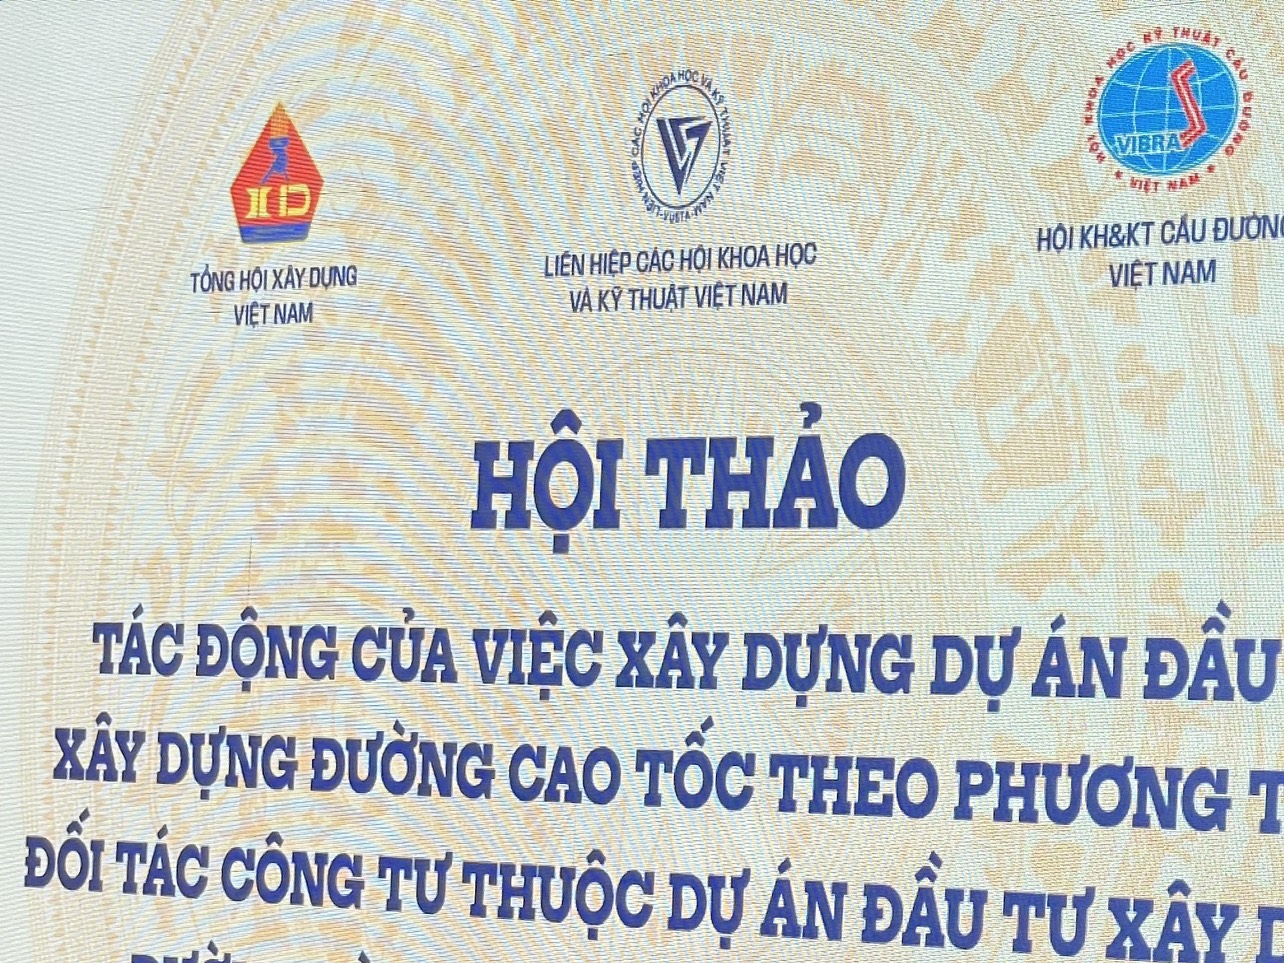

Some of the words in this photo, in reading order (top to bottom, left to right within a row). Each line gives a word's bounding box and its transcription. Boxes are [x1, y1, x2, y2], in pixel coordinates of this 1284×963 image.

[1116, 132, 1182, 156] VIBRA
[1036, 222, 1074, 255] HỘI
[1079, 222, 1156, 250] KH&KT
[1160, 213, 1207, 245] CẦU
[544, 251, 586, 277] LIÊN
[590, 249, 632, 277] HIỆP
[636, 247, 675, 273] CÁC
[680, 244, 713, 273] HỘI
[717, 244, 771, 270] KHOA
[775, 241, 818, 269] HỌC
[1108, 259, 1158, 291] VIỆT
[1162, 259, 1217, 285] NAM
[190, 263, 235, 293] TỔNG
[239, 266, 268, 295] HỘI
[272, 264, 306, 290] XÂY
[309, 265, 358, 291] DỰNG
[569, 286, 593, 313] VÀ
[597, 286, 623, 312] KỸ
[628, 283, 690, 313] THUẬT
[694, 280, 737, 310] VIỆT
[741, 281, 788, 307] NAM
[233, 301, 270, 328] VIỆT
[274, 302, 313, 325] NAM
[471, 409, 623, 553] HỘI
[646, 402, 905, 529] THẢO
[93, 605, 183, 676] TÁC
[196, 607, 338, 691] ĐỘNG
[352, 608, 457, 683] CỦA
[473, 611, 603, 700] VIỆC
[616, 613, 728, 689] XÂY
[742, 625, 914, 707] DỰNG
[931, 627, 1021, 711] DỰ
[1032, 615, 1127, 698] ÁN
[1144, 601, 1280, 701] ĐẦU
[54, 713, 144, 782] XÂY
[157, 726, 297, 799] DỰNG
[311, 721, 495, 798] ĐƯỜNG
[509, 744, 620, 804] CAO
[636, 717, 755, 810] TỐC
[770, 754, 938, 818] THEO
[954, 755, 1230, 831] PHƯƠNG
[25, 809, 103, 891] ĐỐI
[116, 826, 208, 898] TÁC
[222, 832, 364, 908] CÔNG
[378, 852, 452, 914] TƯ
[463, 850, 654, 940] THUỘC
[668, 869, 750, 949] DỰ
[760, 859, 847, 940] ÁN
[862, 852, 987, 949] ĐẦU
[1003, 887, 1094, 956] TƯ
